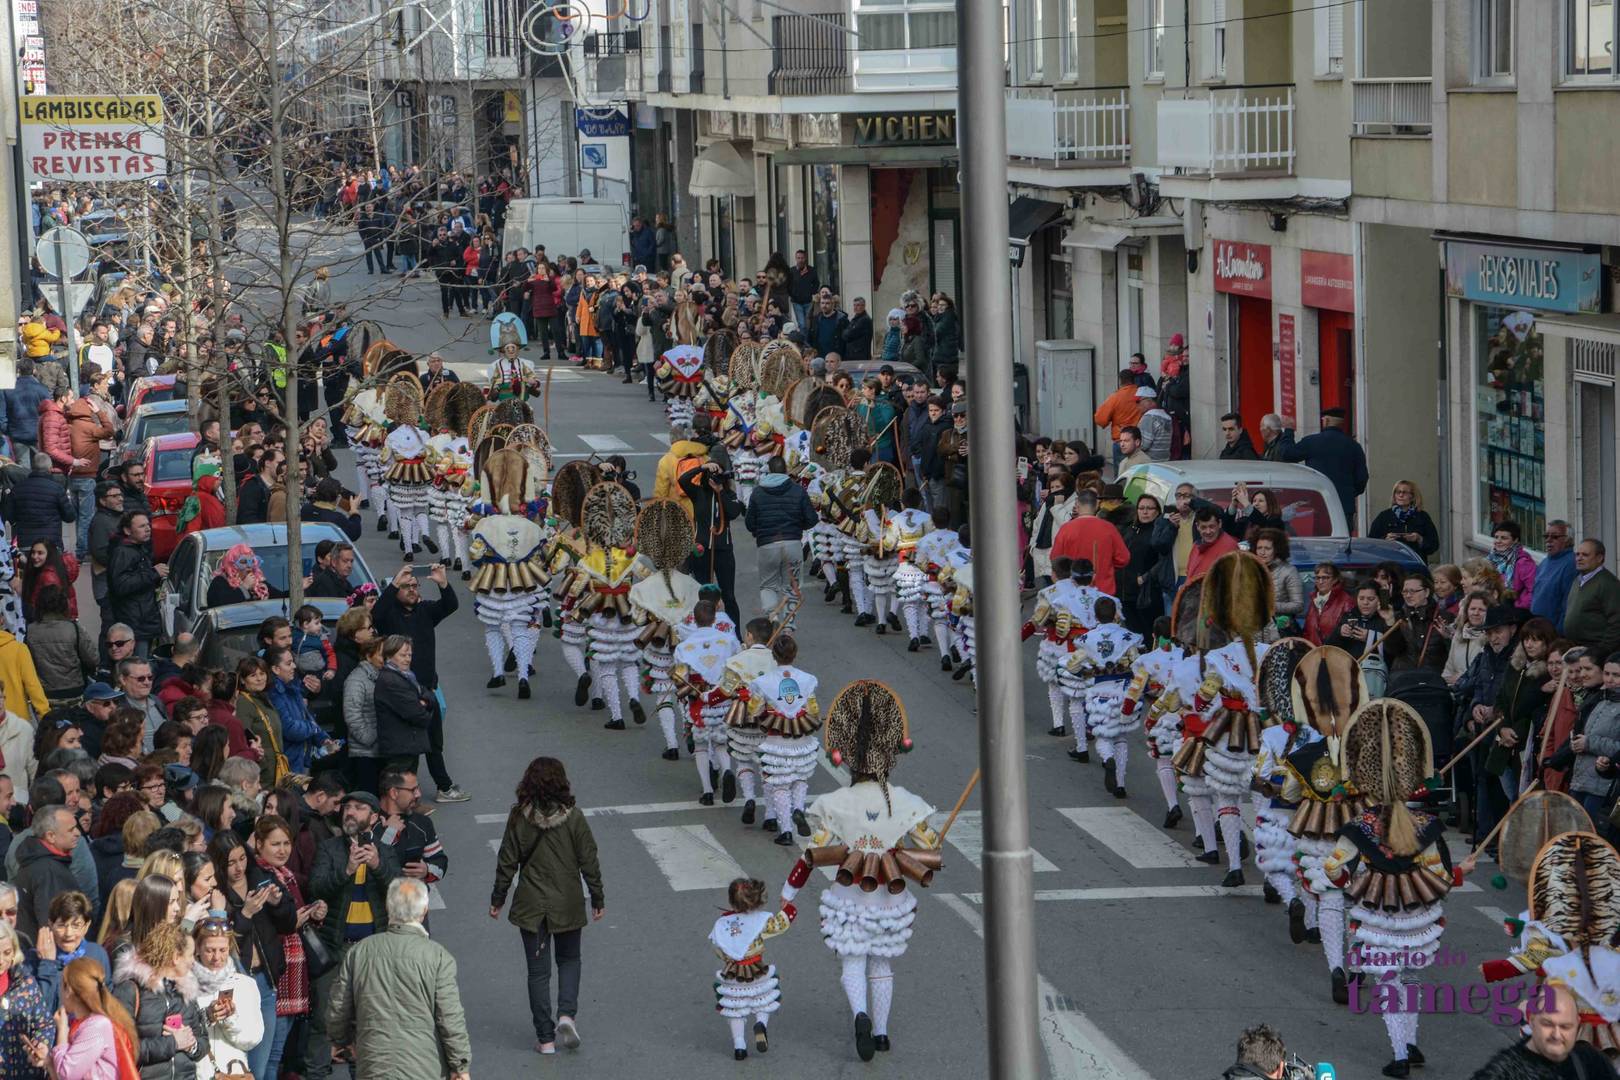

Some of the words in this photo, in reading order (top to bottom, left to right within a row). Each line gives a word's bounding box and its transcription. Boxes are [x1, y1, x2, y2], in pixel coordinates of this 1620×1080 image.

[24, 101, 157, 120] LAMBISCADAS
[856, 115, 957, 142] VICHEN
[43, 131, 142, 151] PRENSA
[32, 155, 155, 175] REVISTAS
